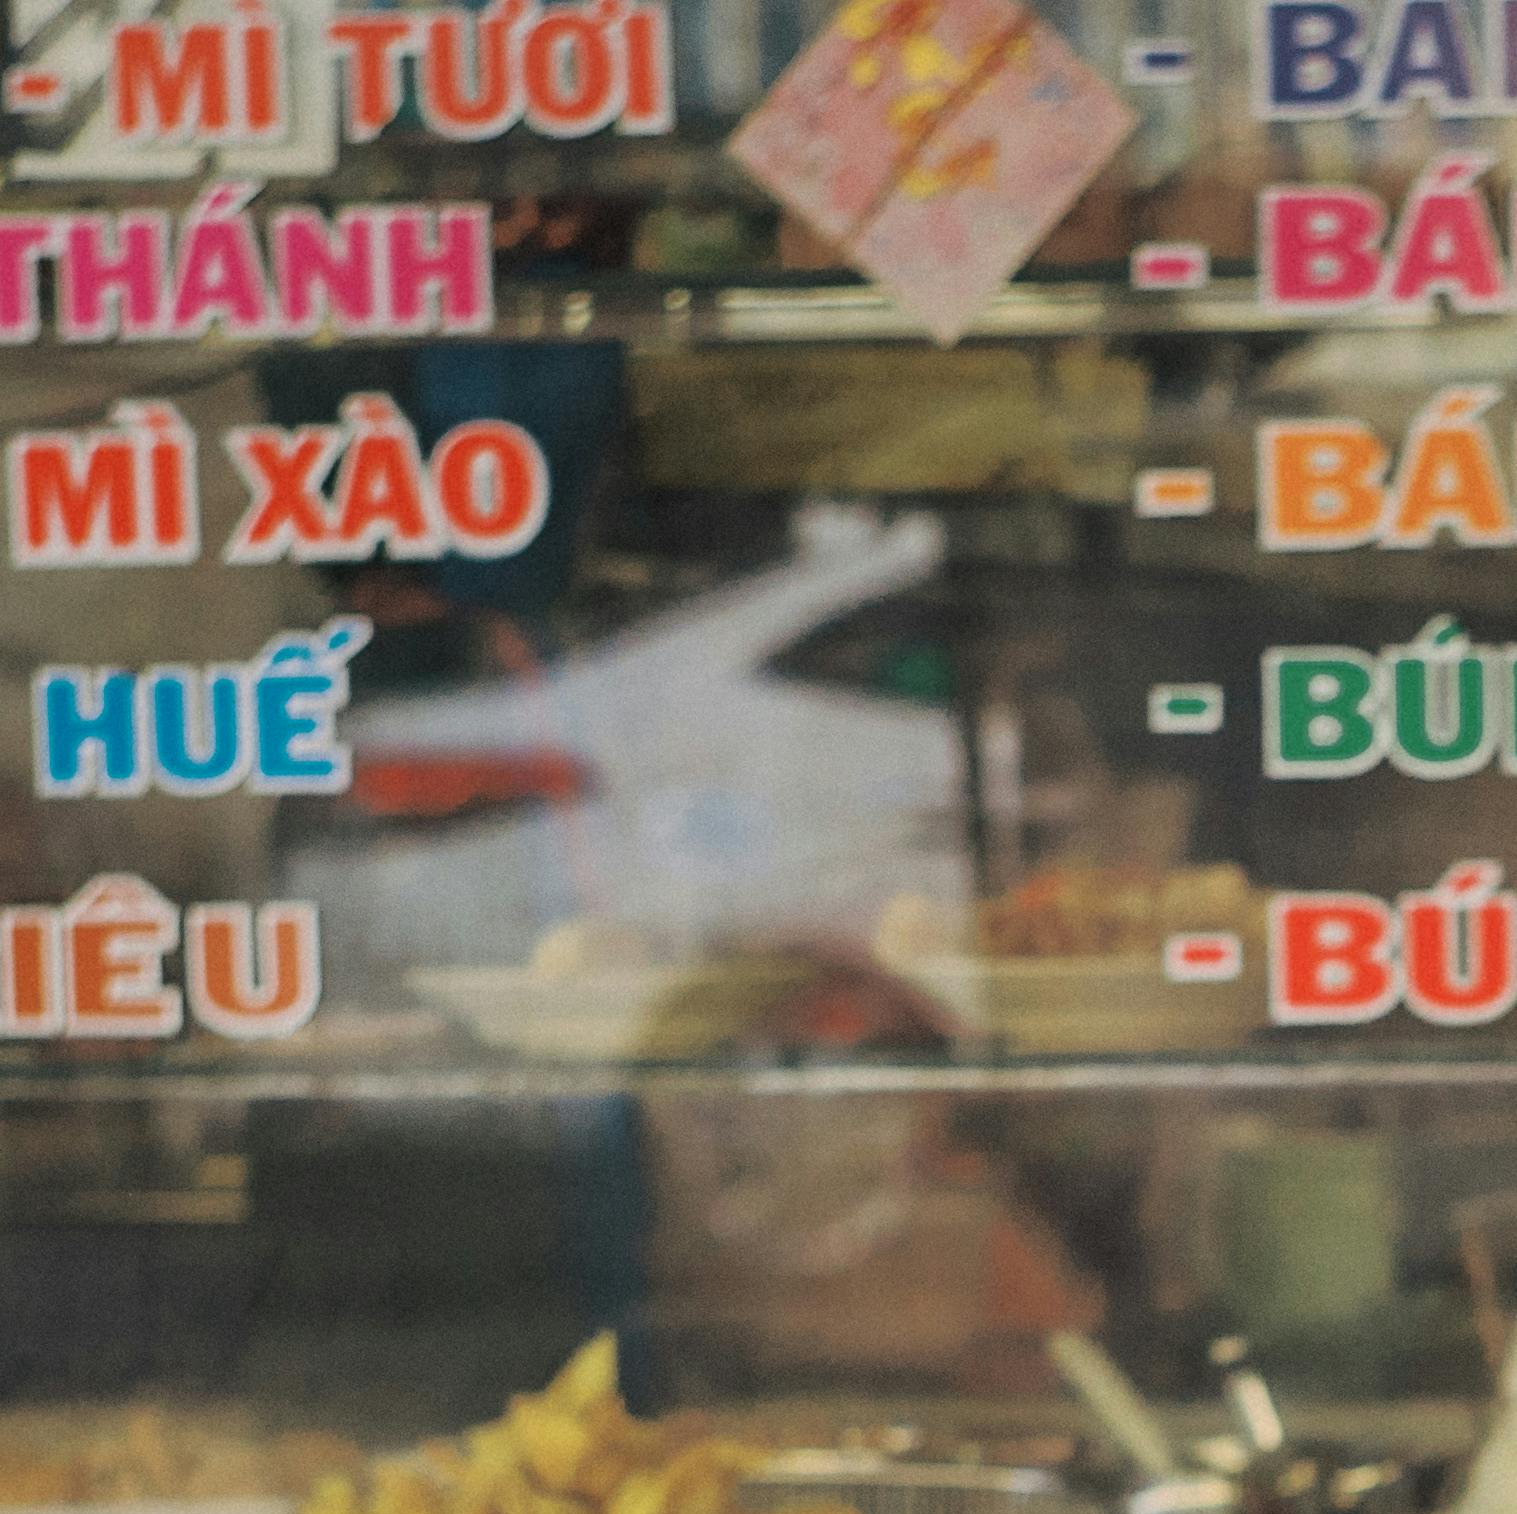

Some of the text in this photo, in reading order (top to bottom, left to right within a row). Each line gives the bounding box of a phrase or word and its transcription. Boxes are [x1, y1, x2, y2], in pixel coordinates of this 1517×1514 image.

[324, 0, 670, 134] TƯƠI
[16, 396, 546, 558] MÌ XÀO
[38, 618, 368, 794] HUẾ
